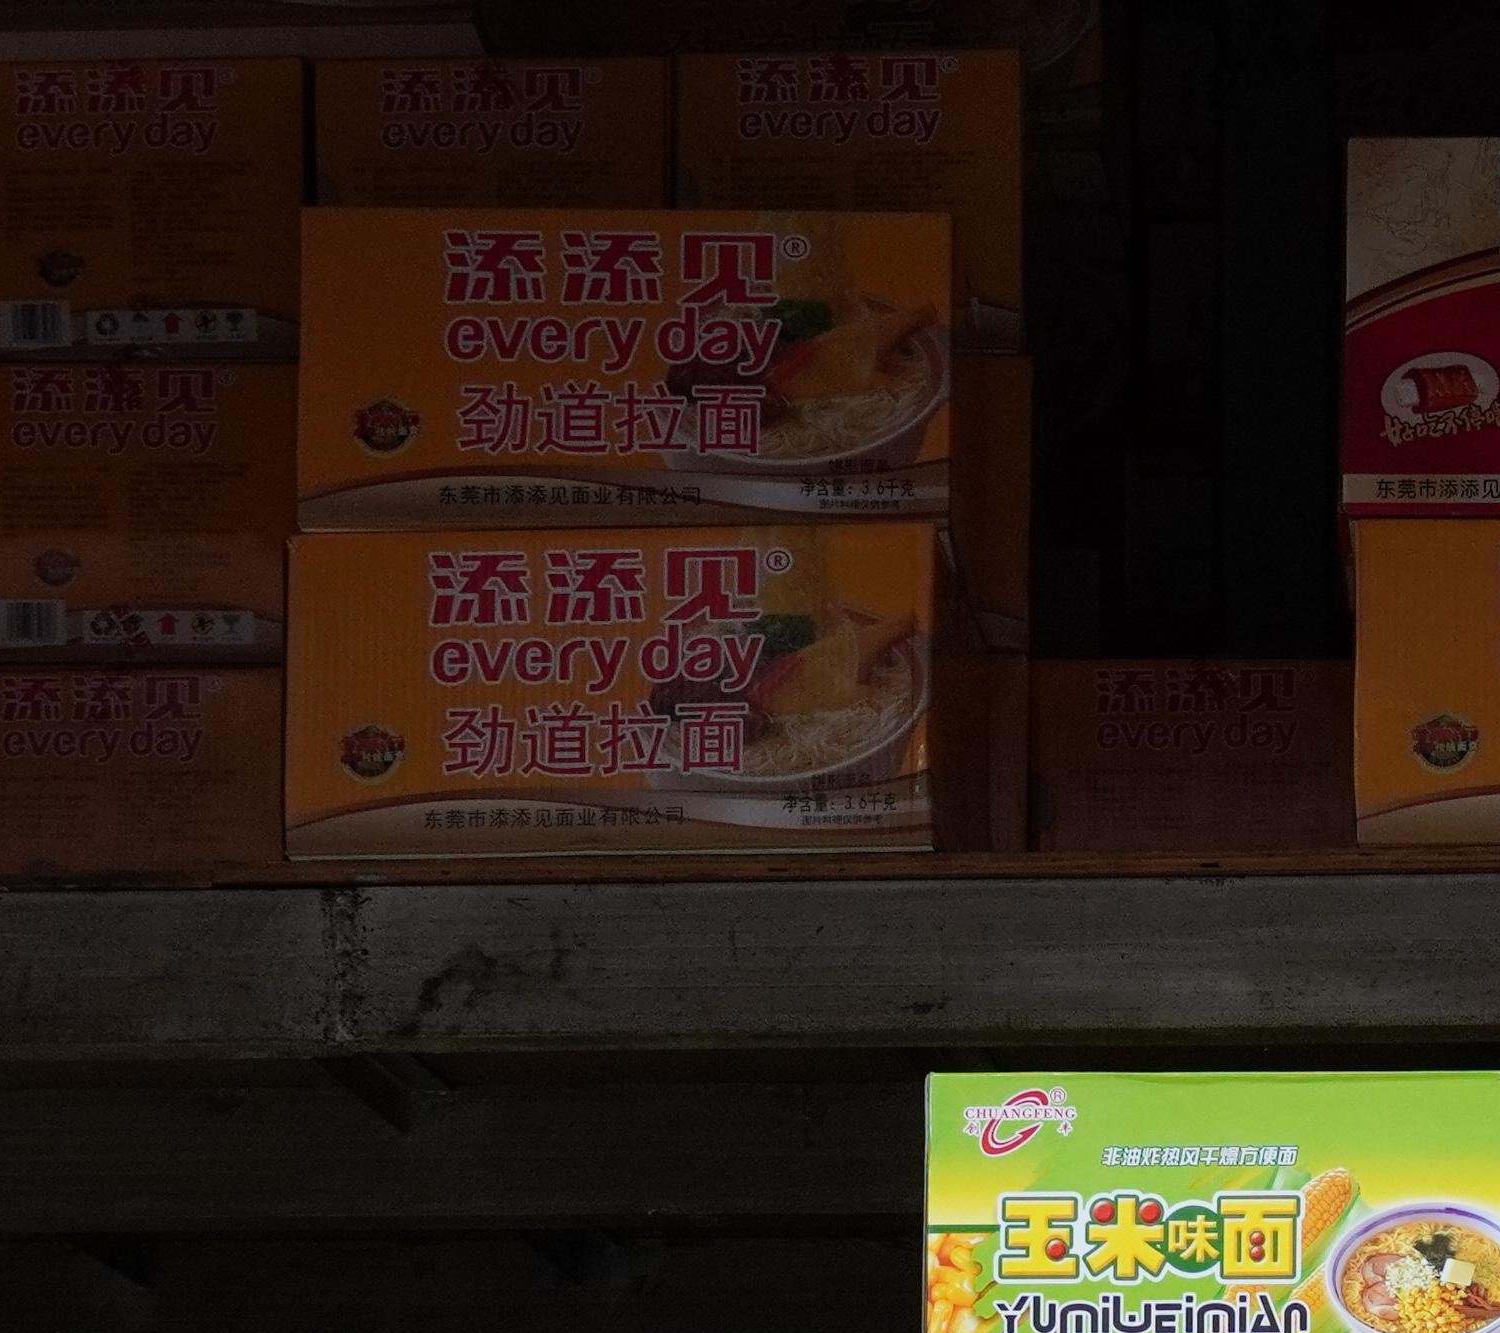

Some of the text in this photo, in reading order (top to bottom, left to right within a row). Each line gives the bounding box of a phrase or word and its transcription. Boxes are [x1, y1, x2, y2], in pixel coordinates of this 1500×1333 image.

[444, 232, 777, 304] 添添见
[446, 304, 781, 372] every day
[460, 382, 761, 457] 劲道拉面
[439, 484, 702, 507] 东莞市添添见面业有限公司
[431, 548, 759, 625] 添添见
[432, 623, 766, 691] every day
[446, 701, 744, 778] 劲道拉面
[964, 1107, 1076, 1121] CHUANGFENG
[1102, 1147, 1298, 1168] 非油炸热风干燥方便面
[999, 1194, 1305, 1282] 玉米味面
